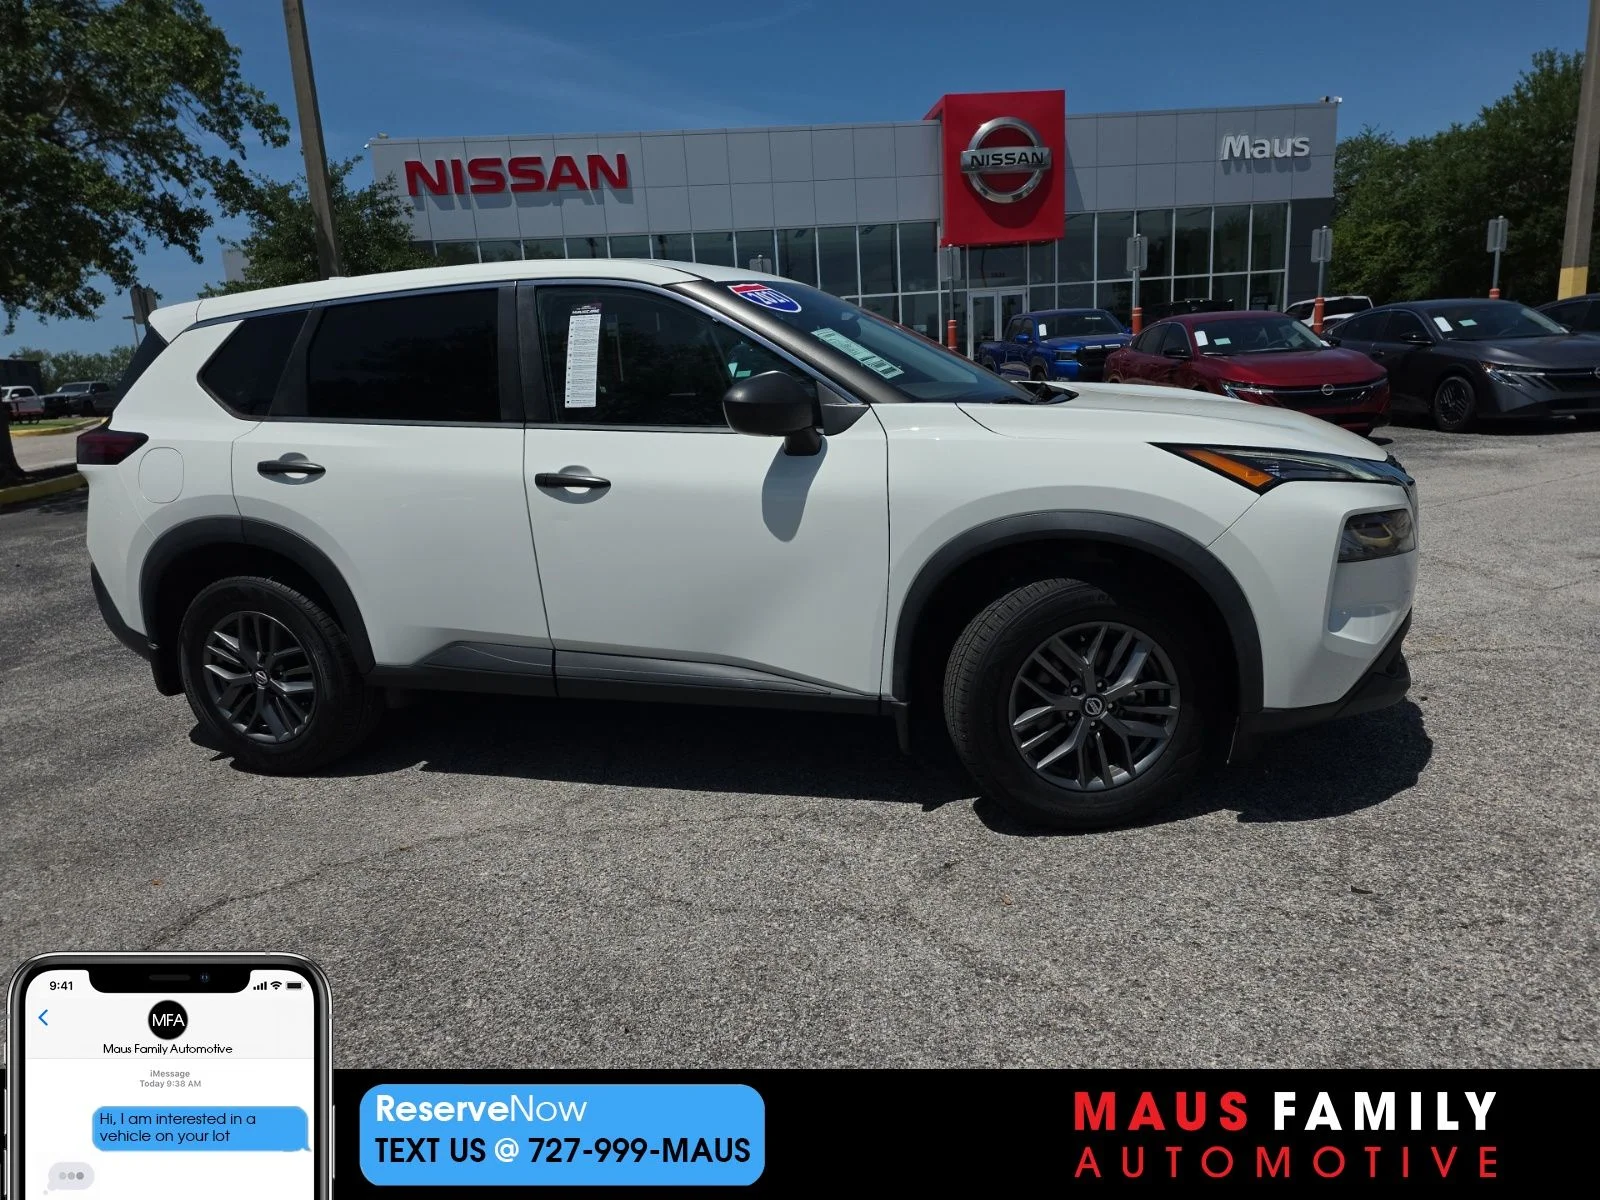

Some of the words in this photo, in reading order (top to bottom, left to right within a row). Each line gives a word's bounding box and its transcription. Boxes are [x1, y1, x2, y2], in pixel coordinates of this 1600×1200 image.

[970, 152, 1045, 167] NISSAN
[1220, 134, 1311, 160] Maus
[405, 154, 628, 197] NISSAN
